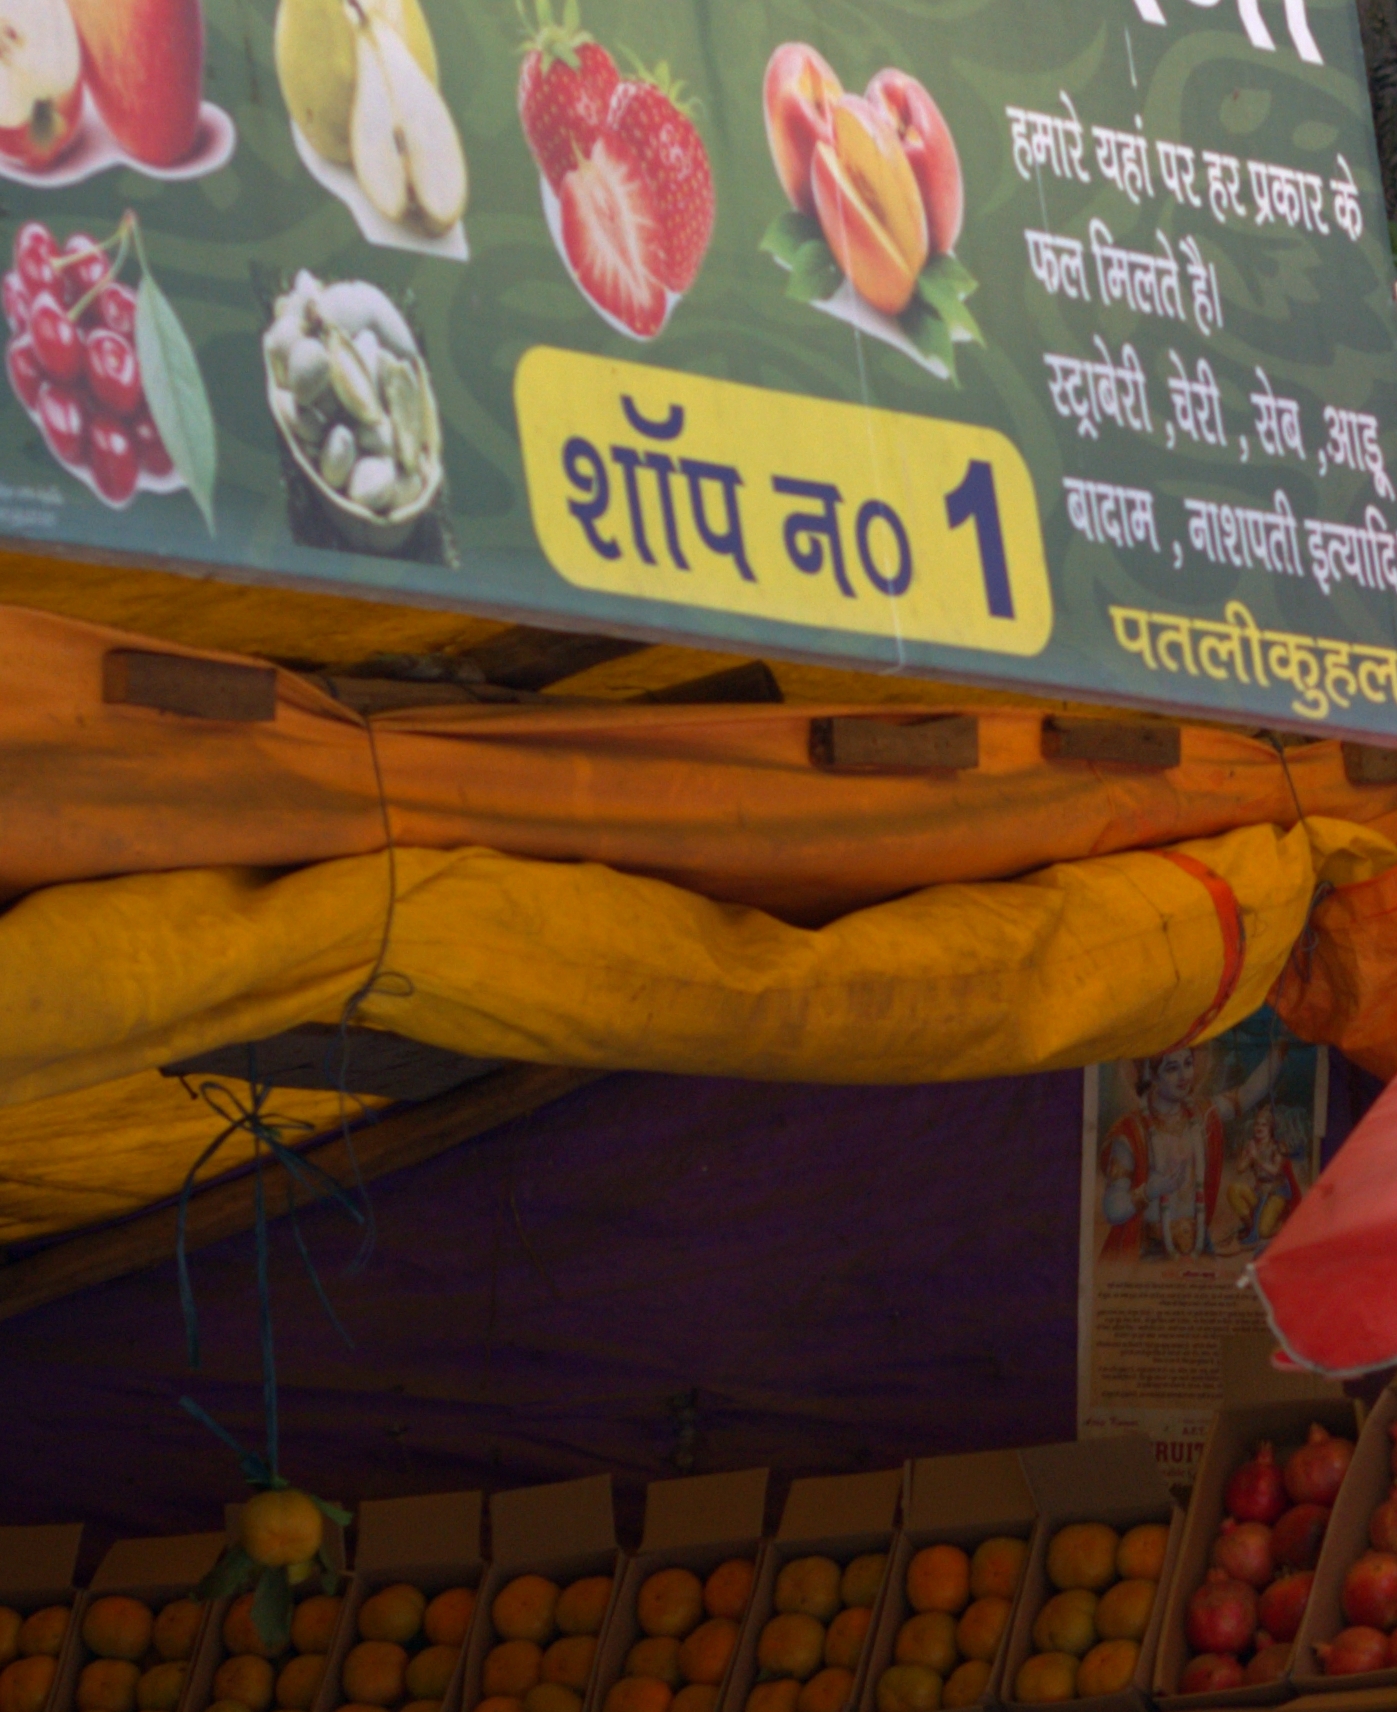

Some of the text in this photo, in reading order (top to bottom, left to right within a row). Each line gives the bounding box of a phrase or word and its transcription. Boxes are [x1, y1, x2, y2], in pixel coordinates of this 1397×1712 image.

[1006, 90, 1363, 241] हमारे यहां पर हर प्रकार के
[1025, 229, 1091, 301] फल
[1089, 217, 1185, 321] मिलते
[1043, 335, 1153, 439] स्ट्राबेरी
[561, 394, 759, 584] शॉप
[944, 458, 1016, 621] 1
[1062, 477, 1161, 553] बादाम
[1184, 489, 1304, 577] नाशपती
